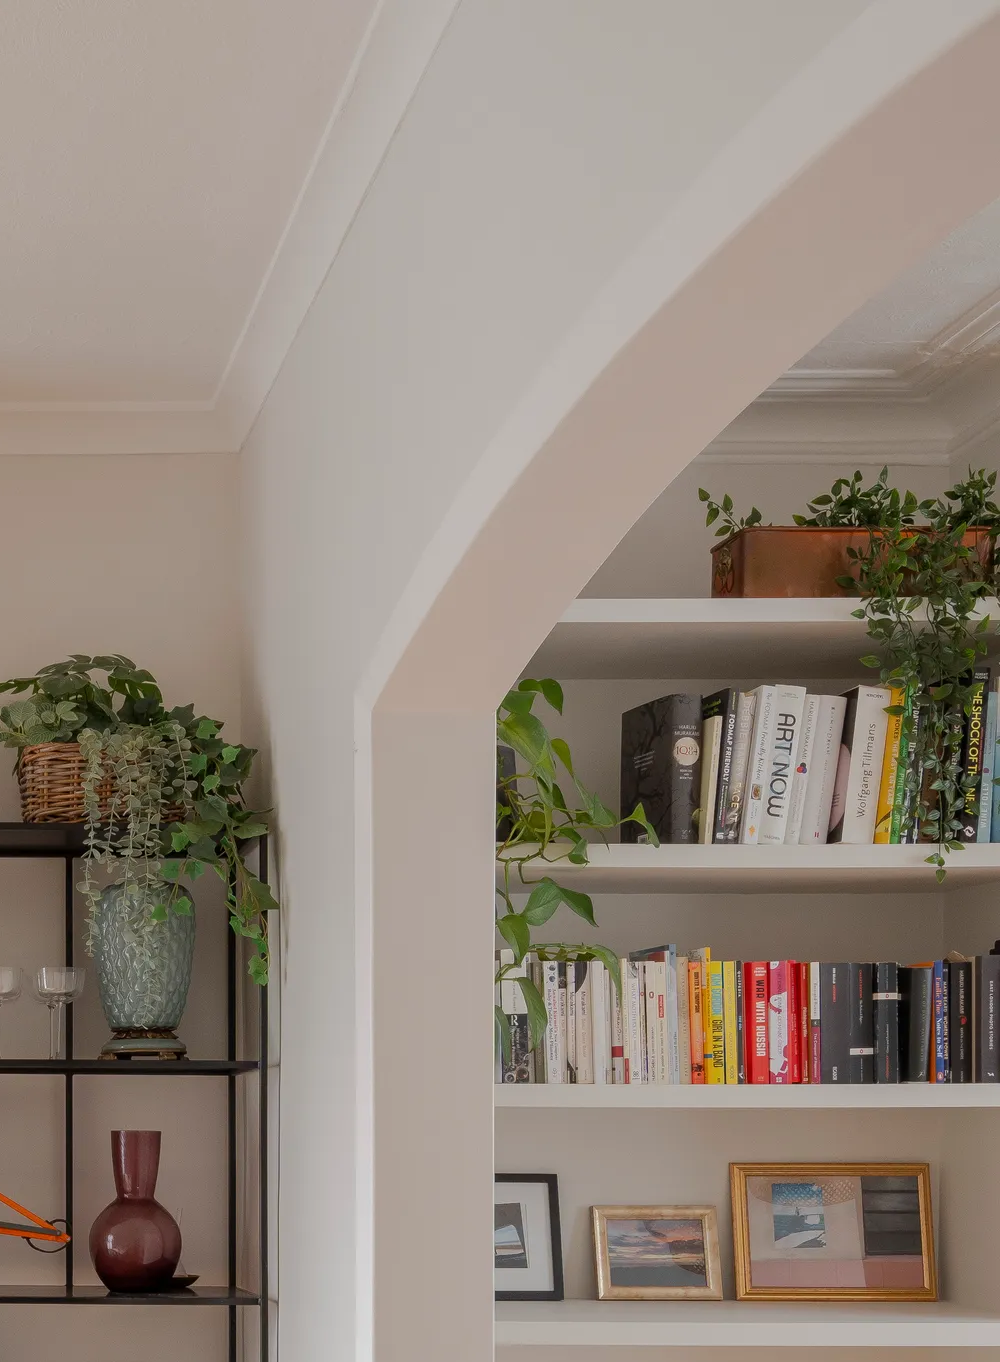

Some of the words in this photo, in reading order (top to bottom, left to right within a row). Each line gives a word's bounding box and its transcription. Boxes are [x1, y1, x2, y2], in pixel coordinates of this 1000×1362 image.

[739, 702, 750, 738] DEBBIE
[806, 701, 815, 725] HARUKI
[970, 706, 982, 746] SHOCK
[726, 714, 736, 745] FODMAP
[774, 713, 796, 756] ART
[801, 726, 811, 760] MURAKAMI
[676, 746, 698, 756] 1Q84
[736, 742, 746, 777] HARRY
[862, 723, 876, 767] Tillmans
[968, 747, 978, 762] OF
[722, 746, 732, 782] FRIENDLY
[730, 782, 742, 808] FACE
[766, 761, 790, 818] NOW
[856, 769, 873, 818] Wolfgang
[894, 792, 903, 824] VICRY
[980, 808, 988, 828] WINE
[712, 974, 721, 986] KIM
[756, 980, 765, 998] WAR
[712, 988, 722, 1016] GORDON
[756, 1001, 765, 1022] WITH
[712, 1020, 722, 1033] GIRL
[756, 1026, 766, 1056] RUSSIA
[713, 1050, 723, 1068] BAND
